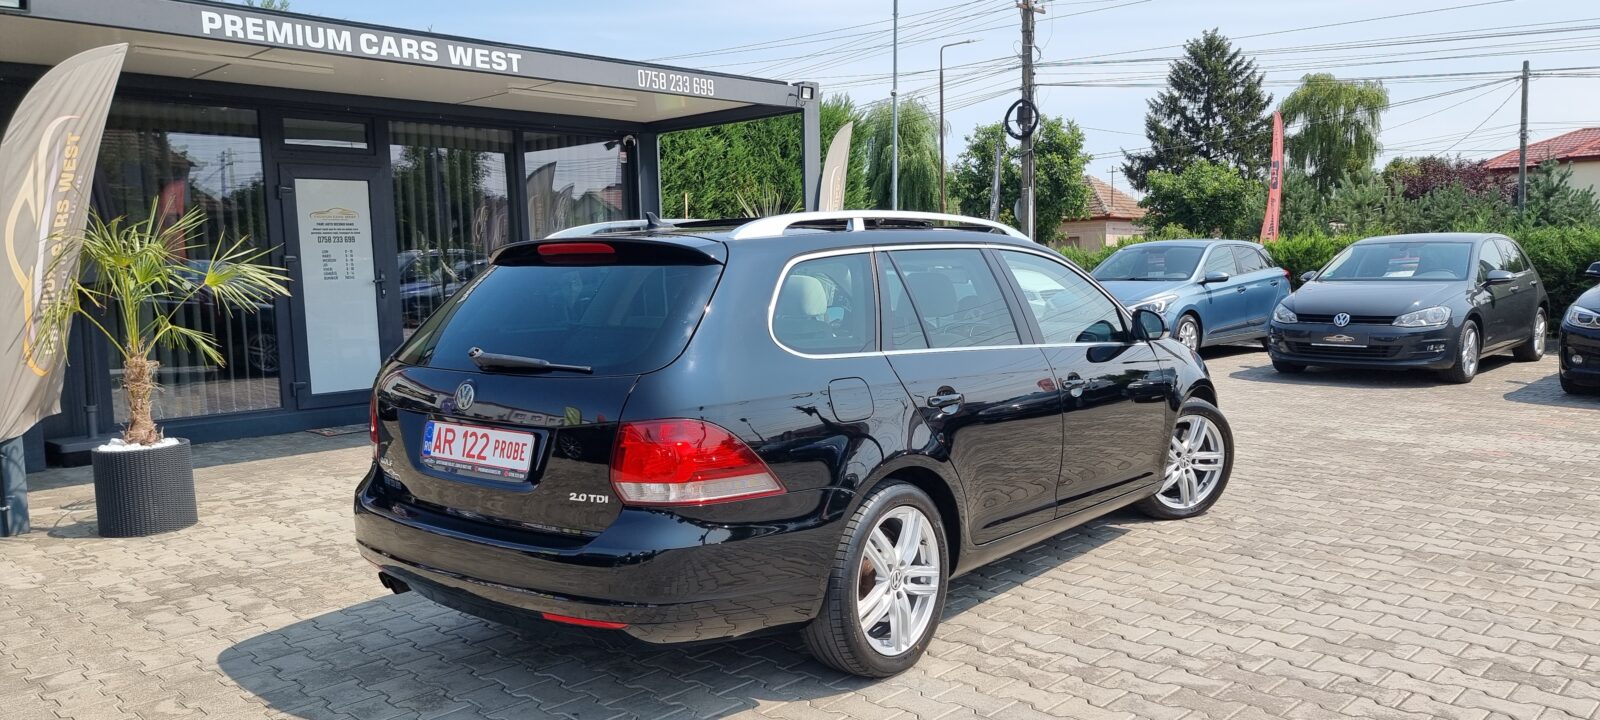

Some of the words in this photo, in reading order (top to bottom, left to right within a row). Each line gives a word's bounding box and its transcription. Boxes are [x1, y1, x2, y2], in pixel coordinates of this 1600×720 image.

[201, 11, 353, 52] PREMIUM
[359, 33, 439, 62] CARS
[447, 45, 522, 73] WEST
[637, 69, 667, 90] 0758
[669, 74, 690, 93] 233
[693, 77, 714, 96] 699
[58, 132, 80, 193] WEST
[433, 426, 456, 456] AR
[462, 430, 490, 461] 122
[493, 439, 528, 461] PROBE
[588, 494, 609, 504] TDI
